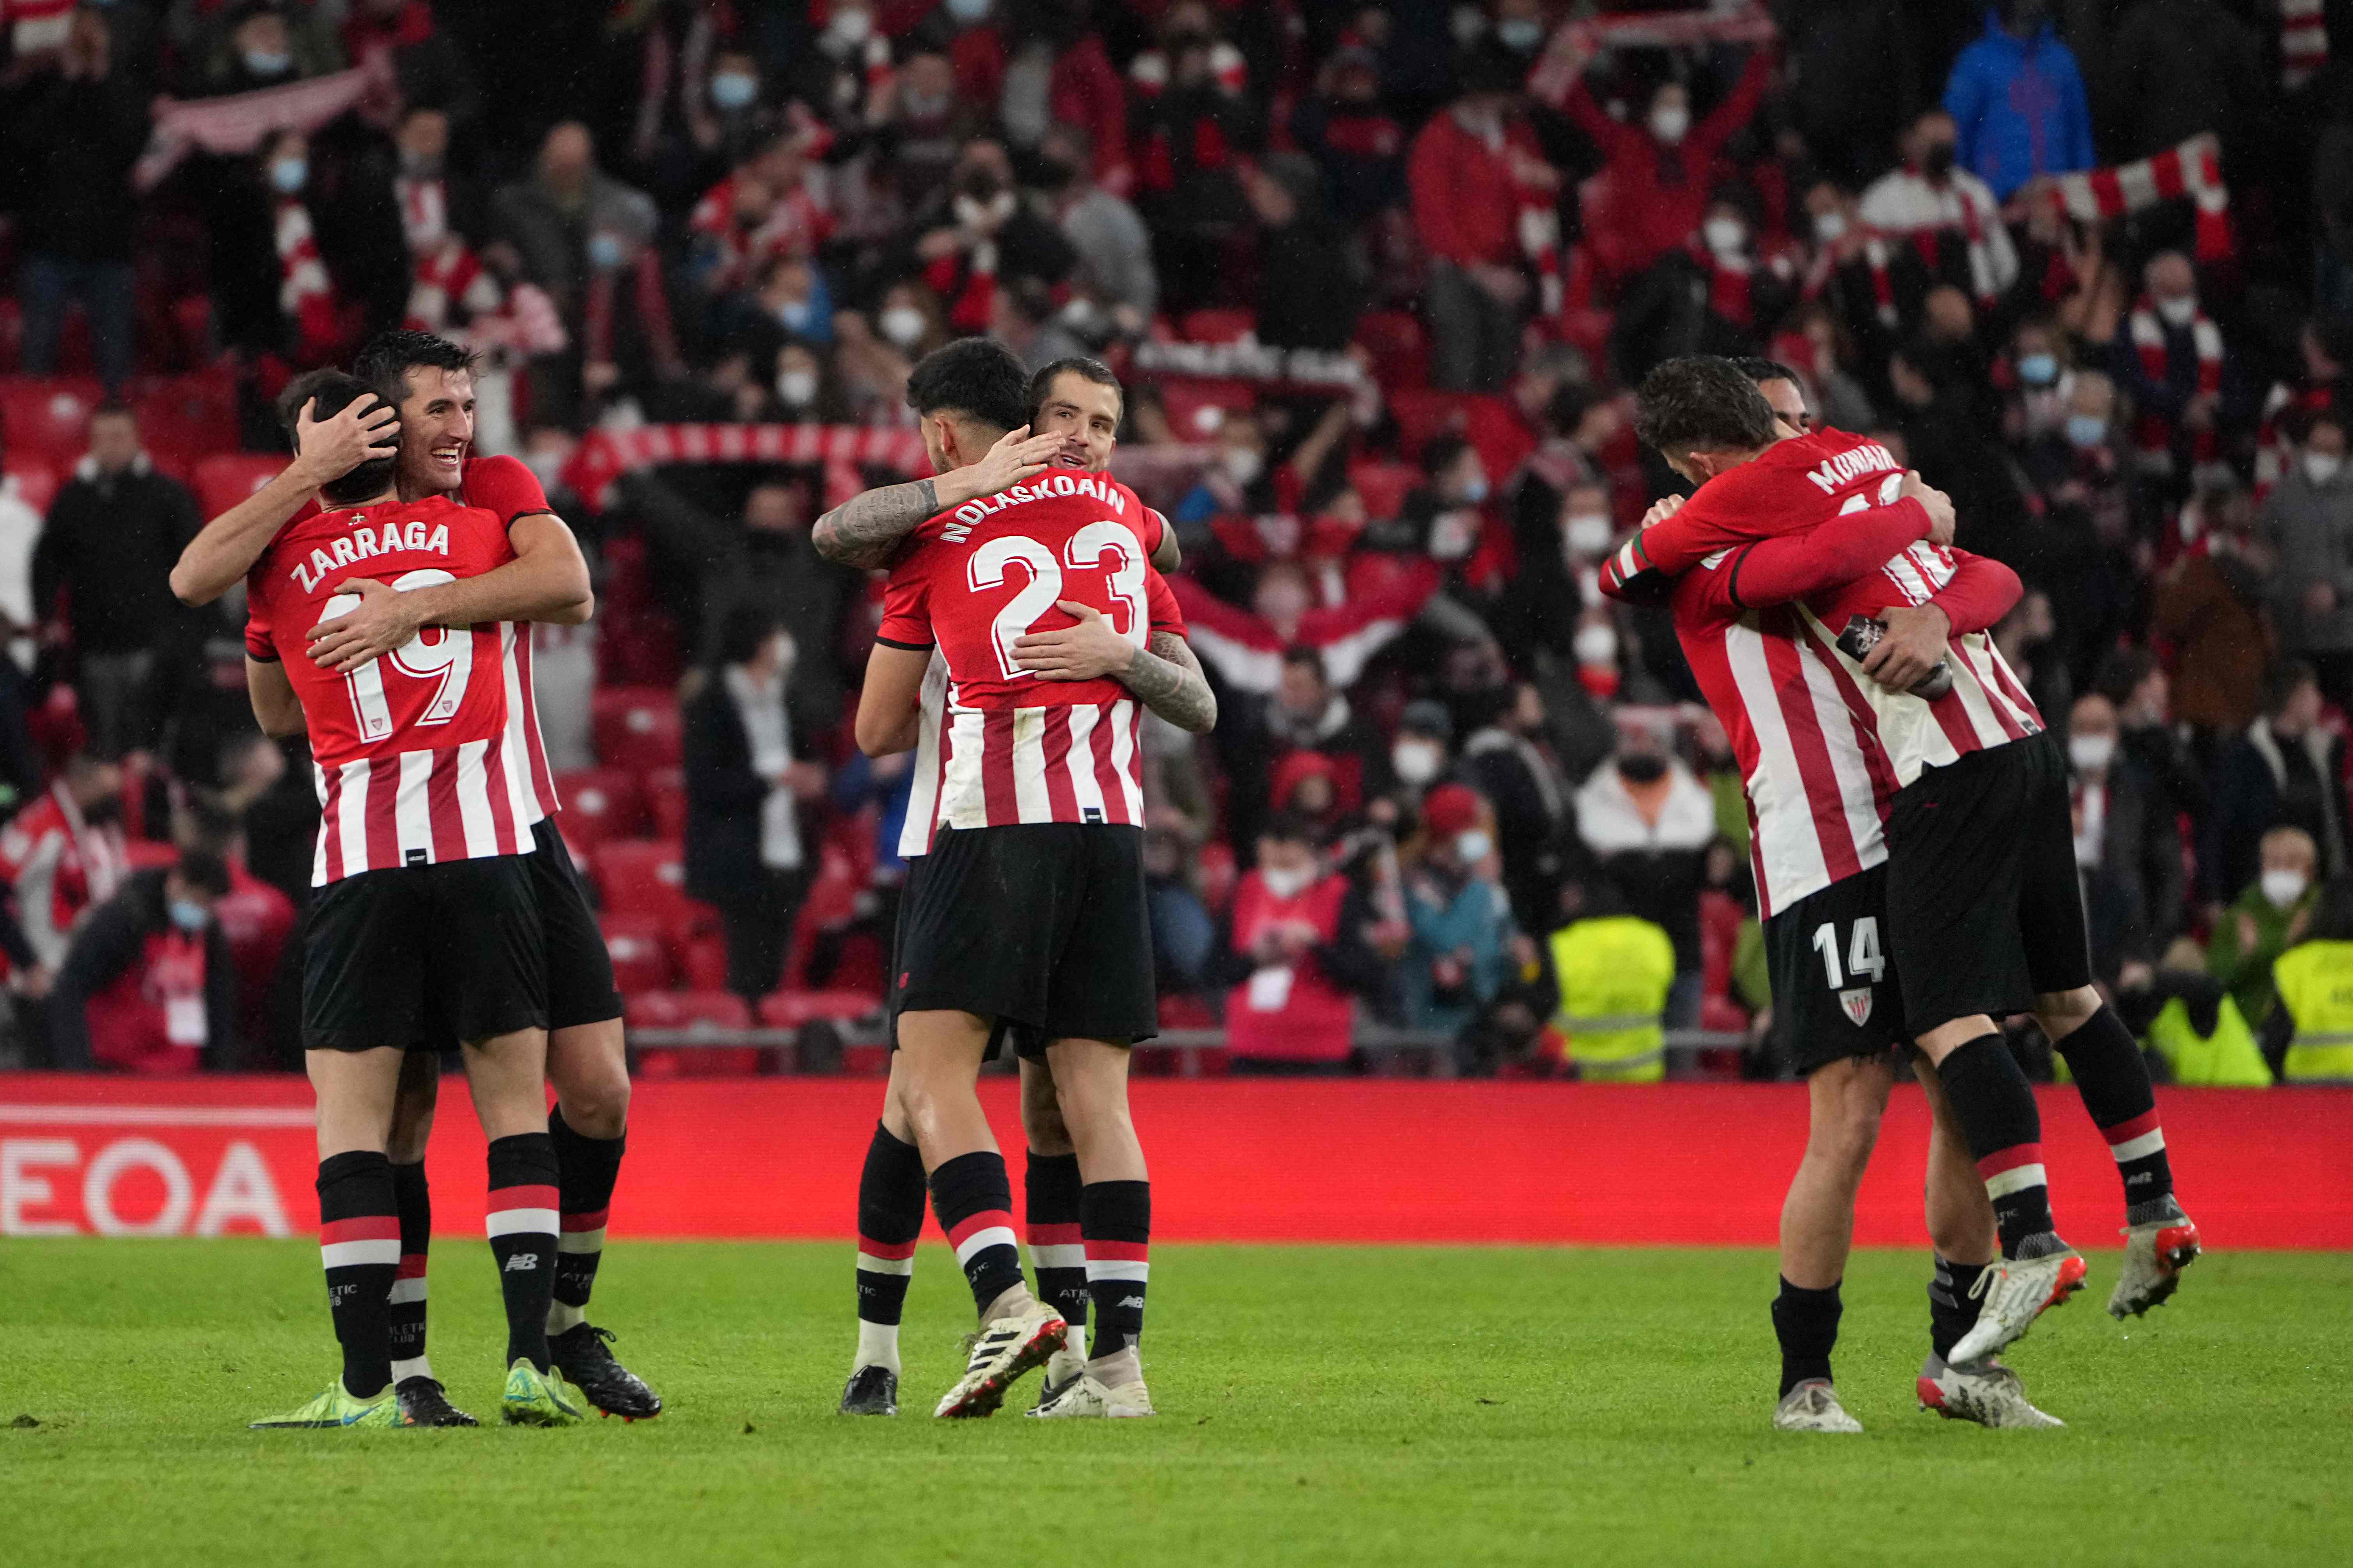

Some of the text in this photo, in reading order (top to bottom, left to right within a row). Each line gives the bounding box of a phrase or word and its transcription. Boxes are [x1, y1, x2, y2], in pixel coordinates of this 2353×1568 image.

[940, 475, 1124, 544] NOLASKOAIN
[290, 521, 449, 594] ZARRAGA
[966, 520, 1148, 680] 23
[315, 569, 472, 744] 19
[1812, 916, 1886, 990] 14
[1, 1138, 293, 1237] EOA
